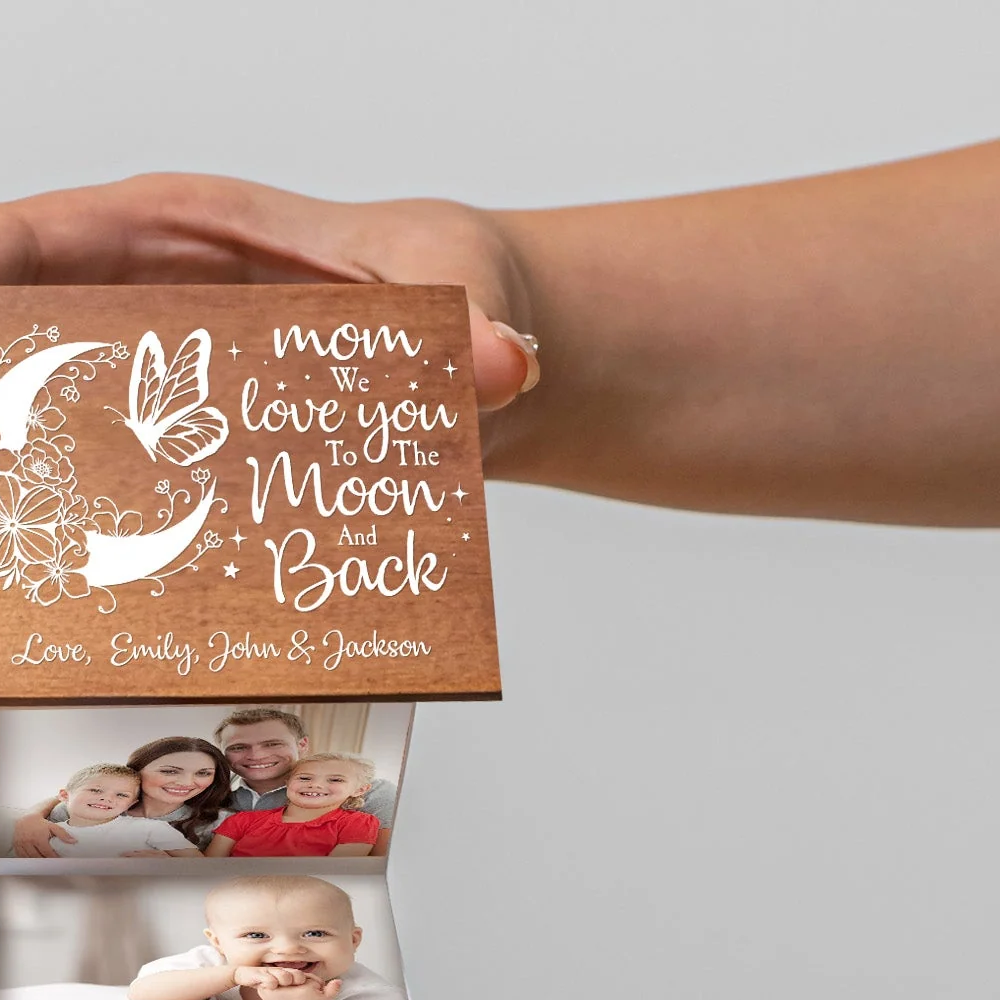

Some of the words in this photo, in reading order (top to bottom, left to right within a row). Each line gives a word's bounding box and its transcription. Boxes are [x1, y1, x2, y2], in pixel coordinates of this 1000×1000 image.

[273, 323, 423, 361] mom
[329, 366, 370, 392] We
[241, 377, 346, 433] love
[357, 399, 458, 463] you
[325, 439, 358, 466] To
[392, 439, 440, 466] The
[246, 451, 446, 524] Moon
[337, 524, 378, 546] And
[264, 528, 448, 612] Back
[11, 632, 92, 666] Love,
[110, 631, 200, 676] Emily,
[208, 631, 281, 672] John
[287, 629, 315, 665] &
[322, 629, 432, 671] Jackson
